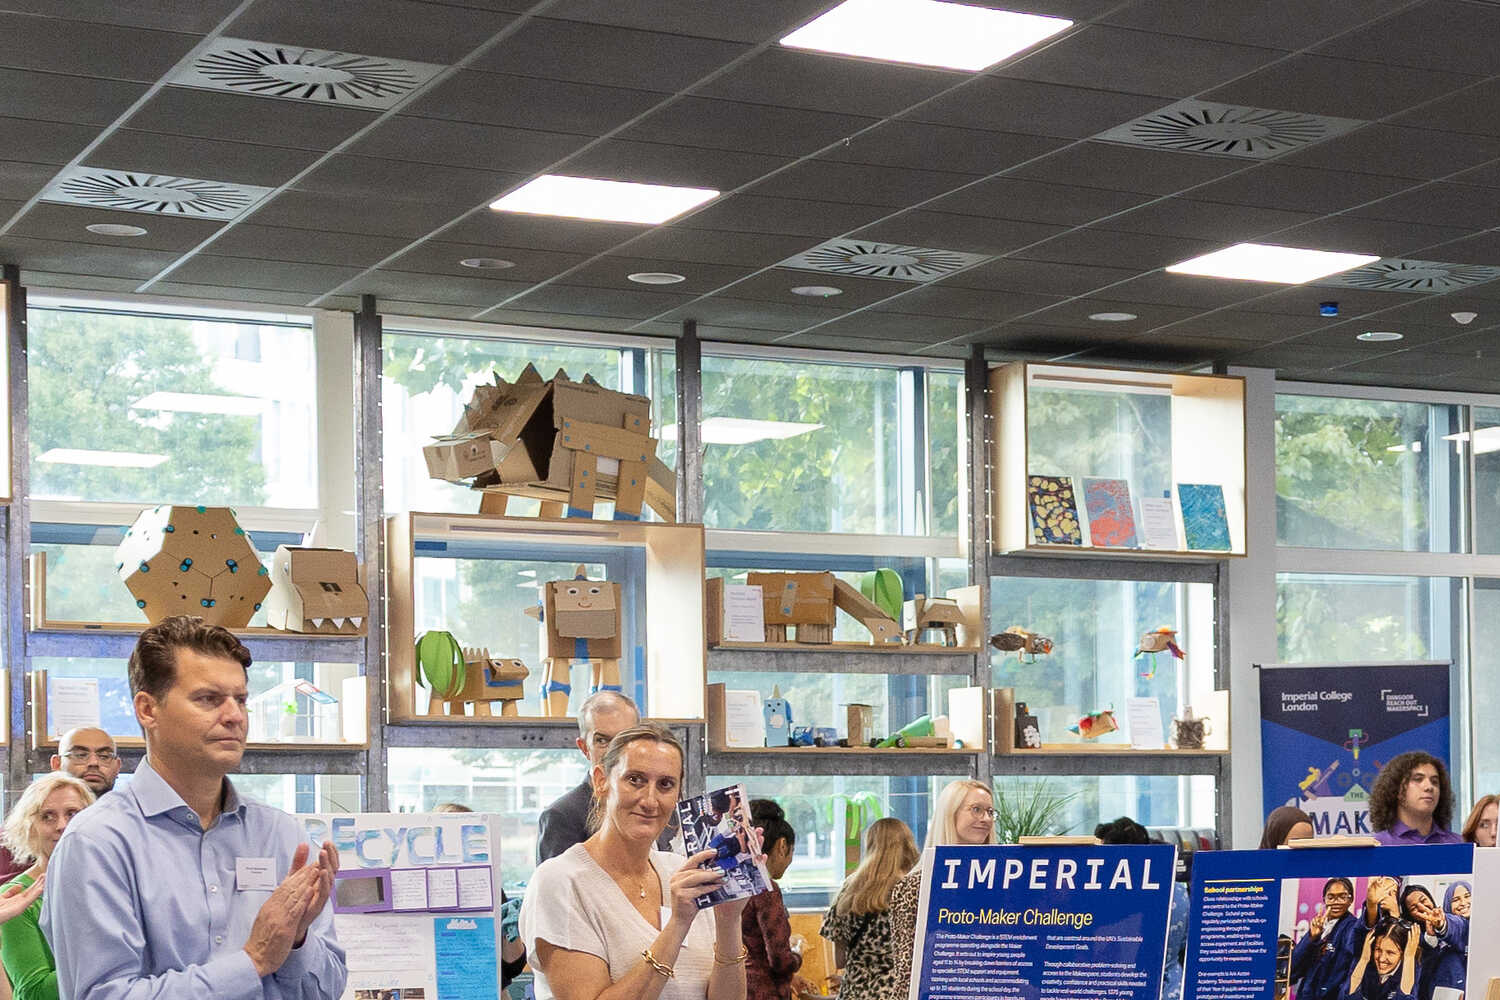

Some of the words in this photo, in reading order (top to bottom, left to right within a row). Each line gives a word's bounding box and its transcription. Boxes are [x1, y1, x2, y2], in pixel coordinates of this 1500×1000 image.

[1282, 692, 1318, 702] Imperial
[1320, 691, 1352, 702] College
[1282, 702, 1318, 712] London
[941, 859, 1160, 890] IMPERIAL
[938, 908, 1021, 925] Proto-Maker
[1023, 909, 1093, 930] Challenge
